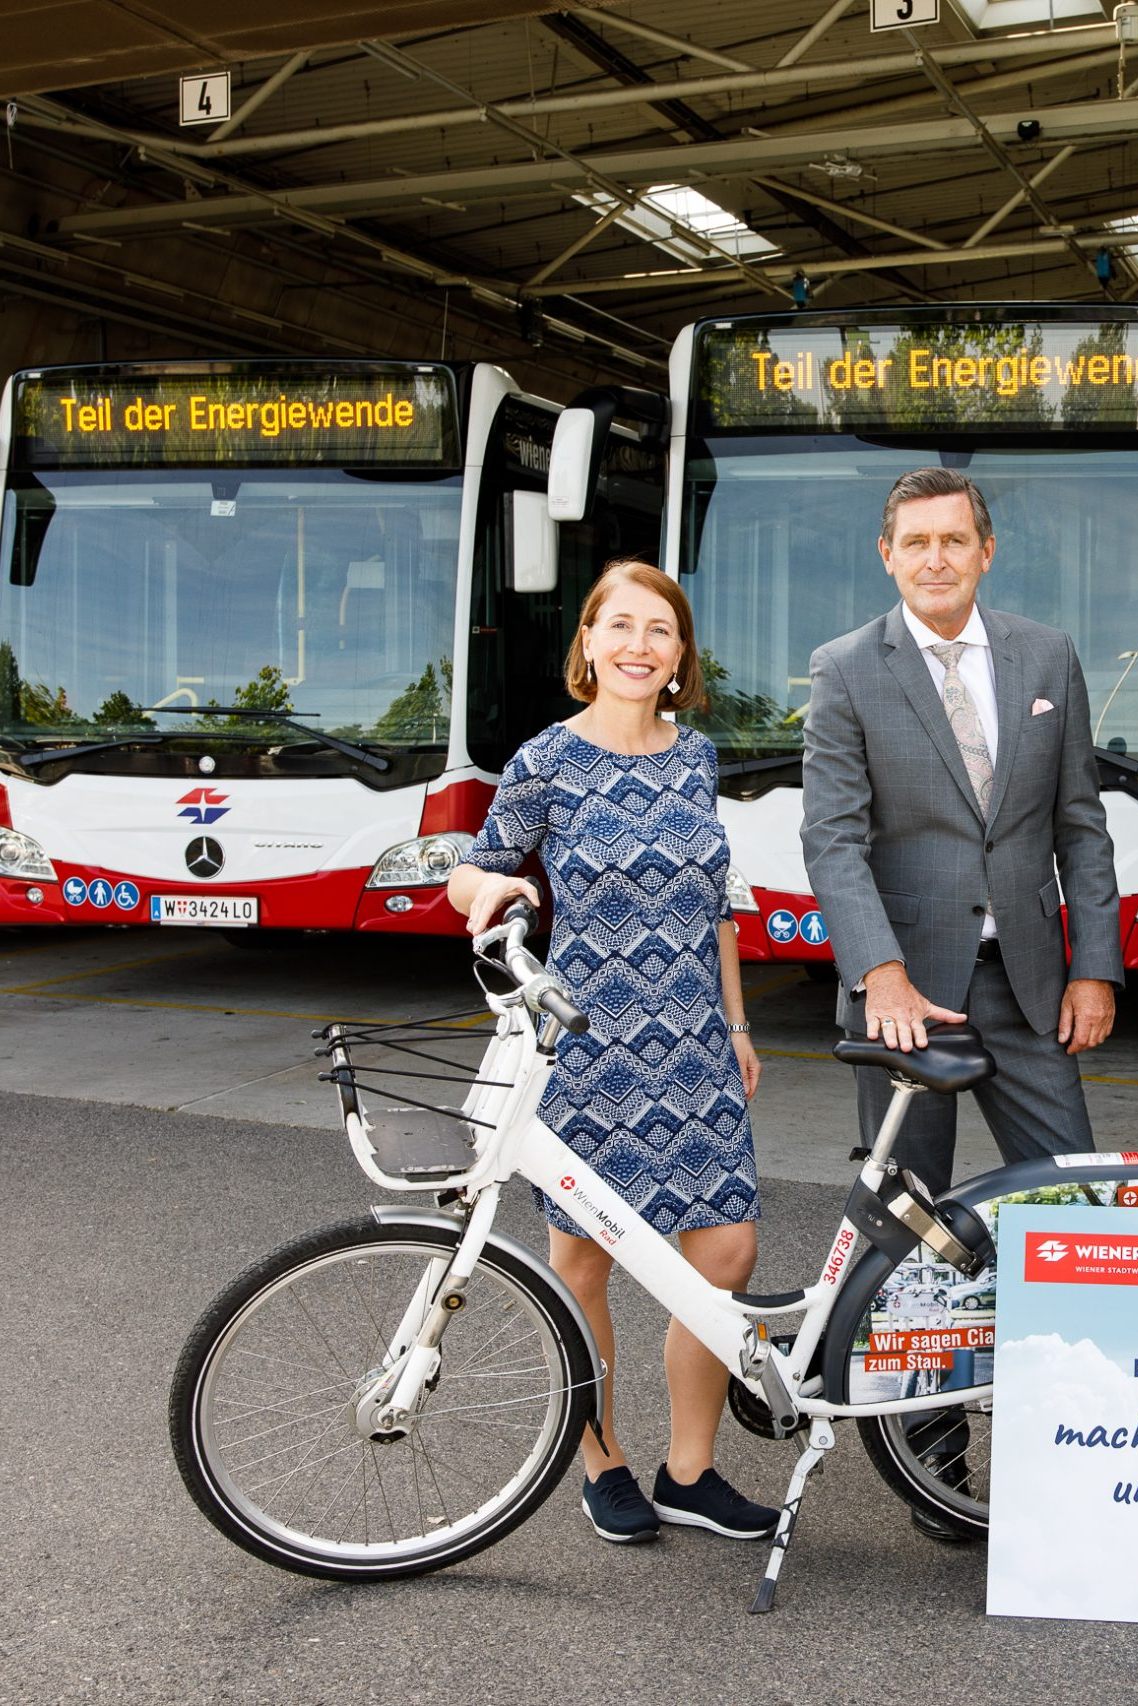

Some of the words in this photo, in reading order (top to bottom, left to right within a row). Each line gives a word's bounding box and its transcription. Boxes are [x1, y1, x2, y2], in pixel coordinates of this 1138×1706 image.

[198, 81, 212, 115] 4
[752, 351, 814, 391] Teil
[828, 351, 893, 390] der
[60, 397, 112, 432] Teil
[124, 397, 176, 431] der
[190, 393, 414, 437] Energiewende
[165, 900, 175, 916] W
[573, 1187, 626, 1239] WienMobil
[599, 1229, 617, 1246] Rad
[823, 1229, 854, 1285] 346738
[874, 1334, 905, 1351] Wir
[911, 1333, 961, 1352] sagen
[868, 1358, 901, 1371] zum
[906, 1354, 946, 1370] Stau.
